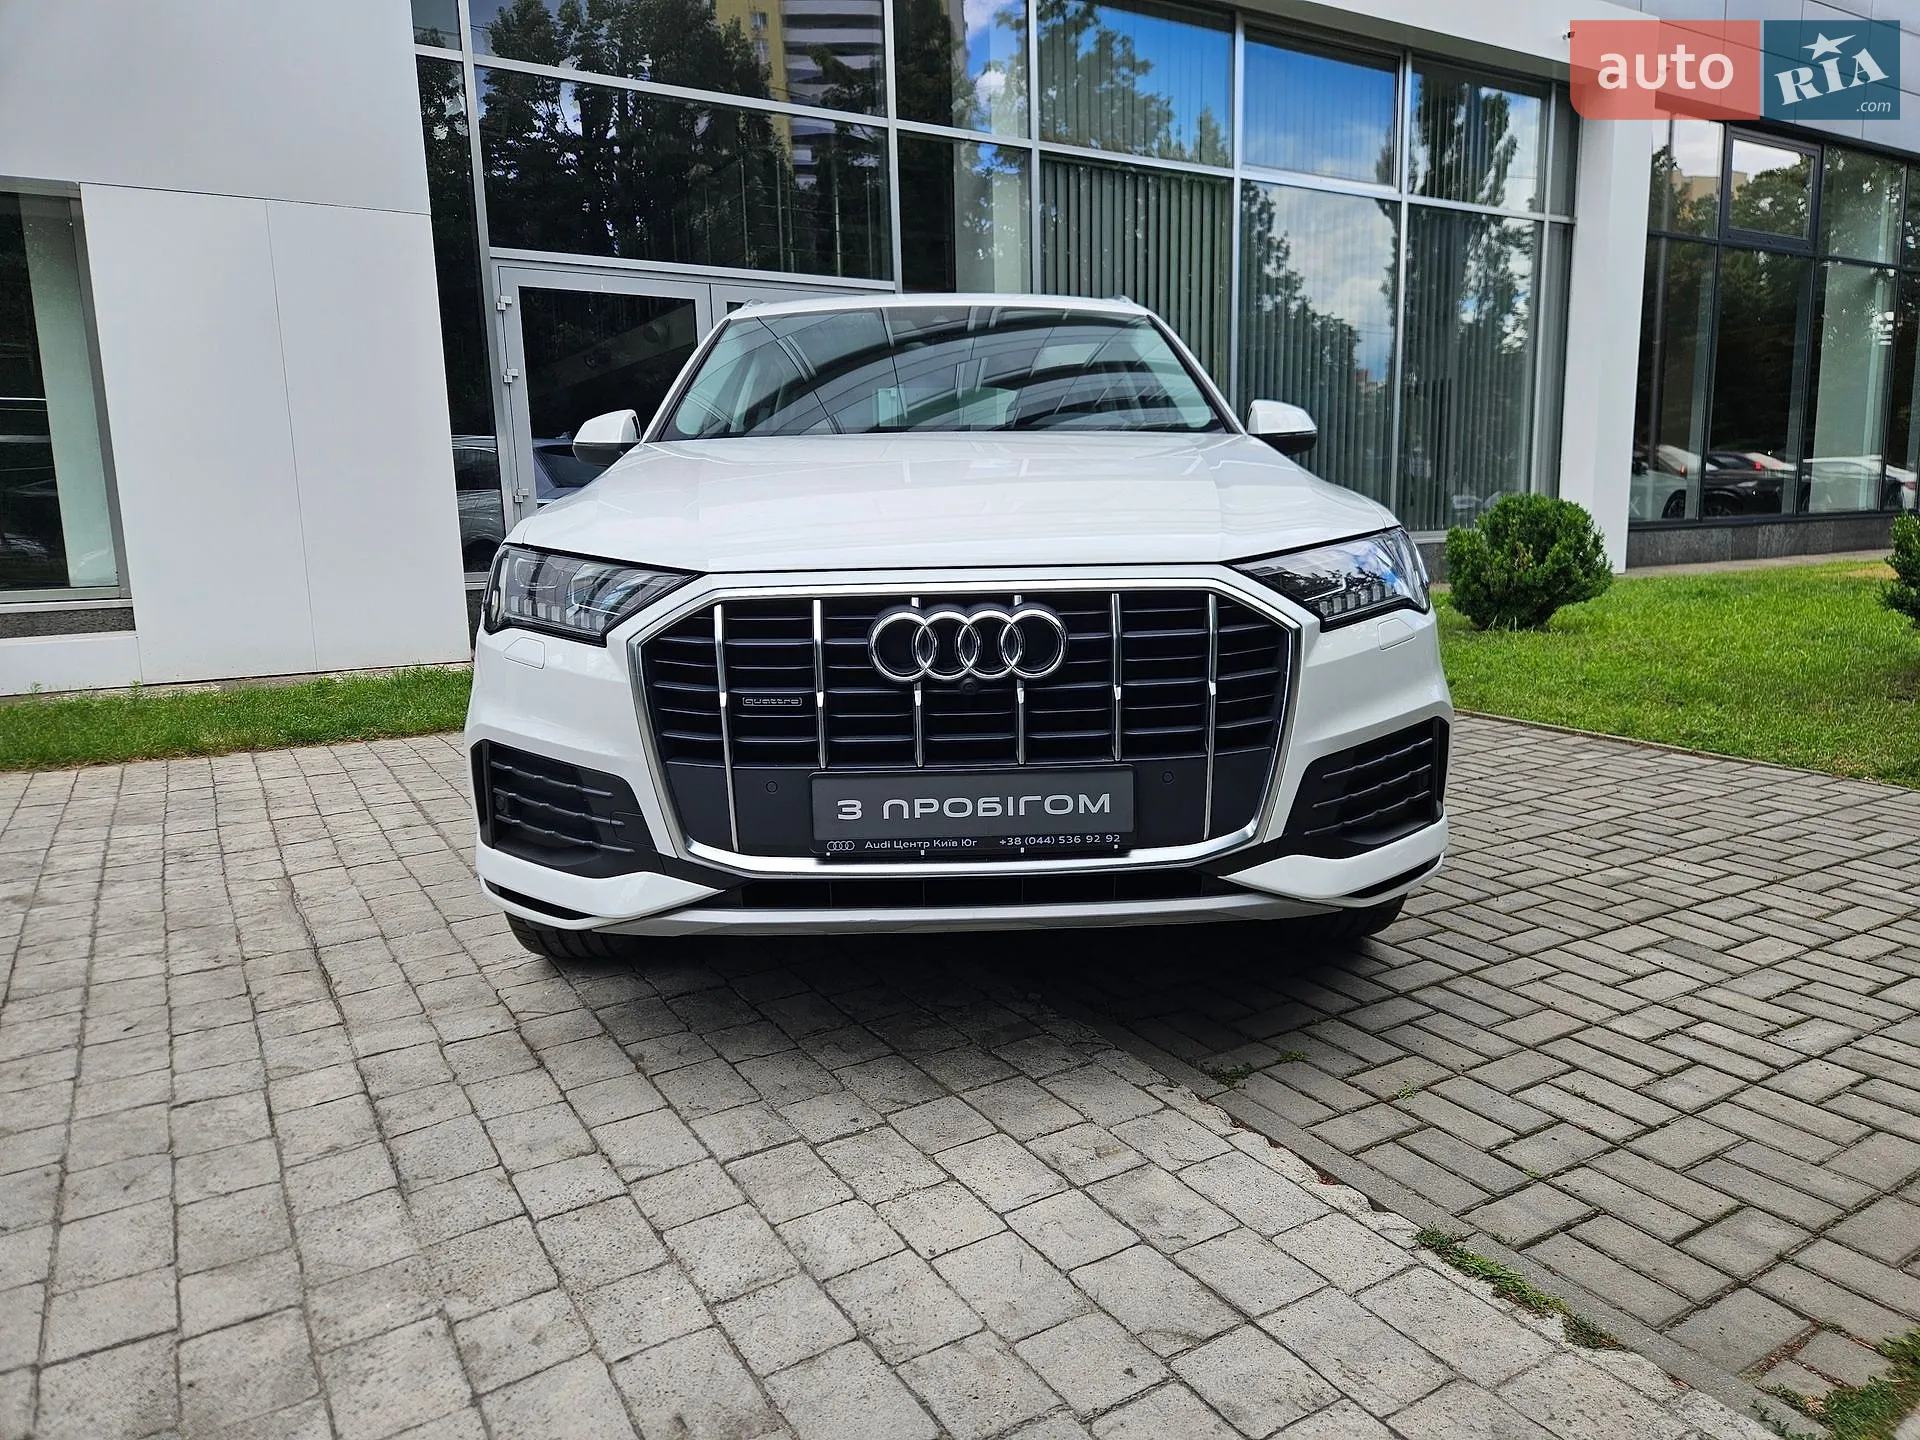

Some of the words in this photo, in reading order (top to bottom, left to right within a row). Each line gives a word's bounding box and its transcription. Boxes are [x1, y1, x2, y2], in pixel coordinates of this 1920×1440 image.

[744, 698, 800, 706] quattro
[882, 793, 1111, 820] ПРОБІГОМ
[864, 840, 890, 850] Audi
[893, 839, 931, 851] Центр
[933, 838, 958, 849] Київ
[960, 839, 978, 850] Юг
[1000, 837, 1022, 847] +38
[1024, 835, 1056, 847] (044)
[1058, 835, 1081, 845] 536
[1085, 834, 1101, 845] 92
[1105, 834, 1121, 844] 92
